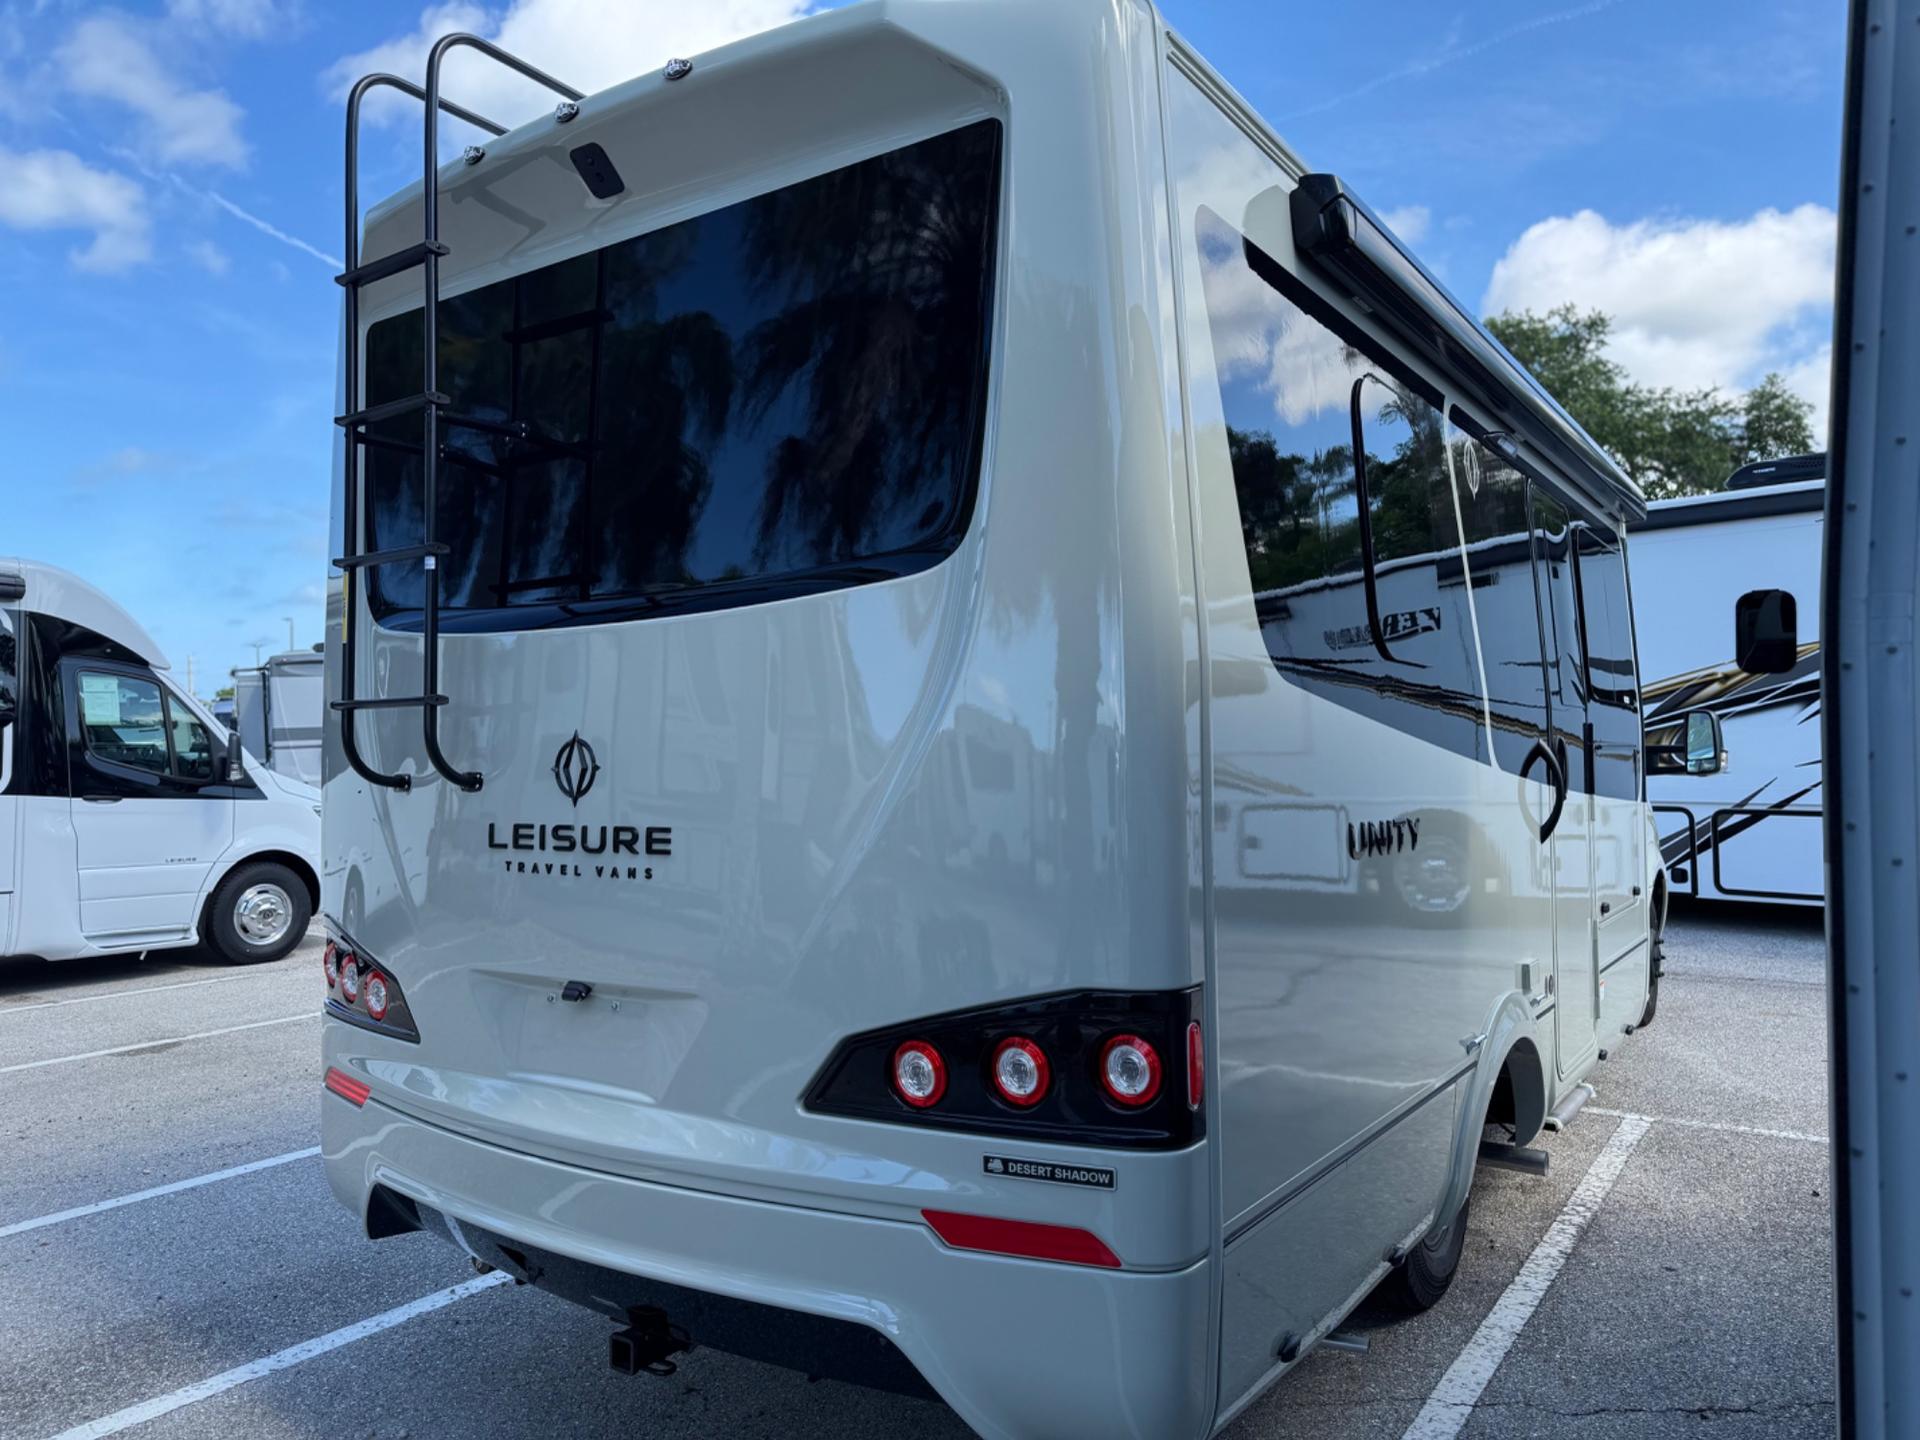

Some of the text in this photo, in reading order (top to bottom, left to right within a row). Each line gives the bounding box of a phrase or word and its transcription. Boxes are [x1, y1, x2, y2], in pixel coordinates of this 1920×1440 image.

[488, 823, 672, 856] LEISURE
[1347, 818, 1420, 860] UNITY
[505, 861, 653, 880] TRAVEL VANS
[1008, 1162, 1111, 1184] DESERT SHADOW
